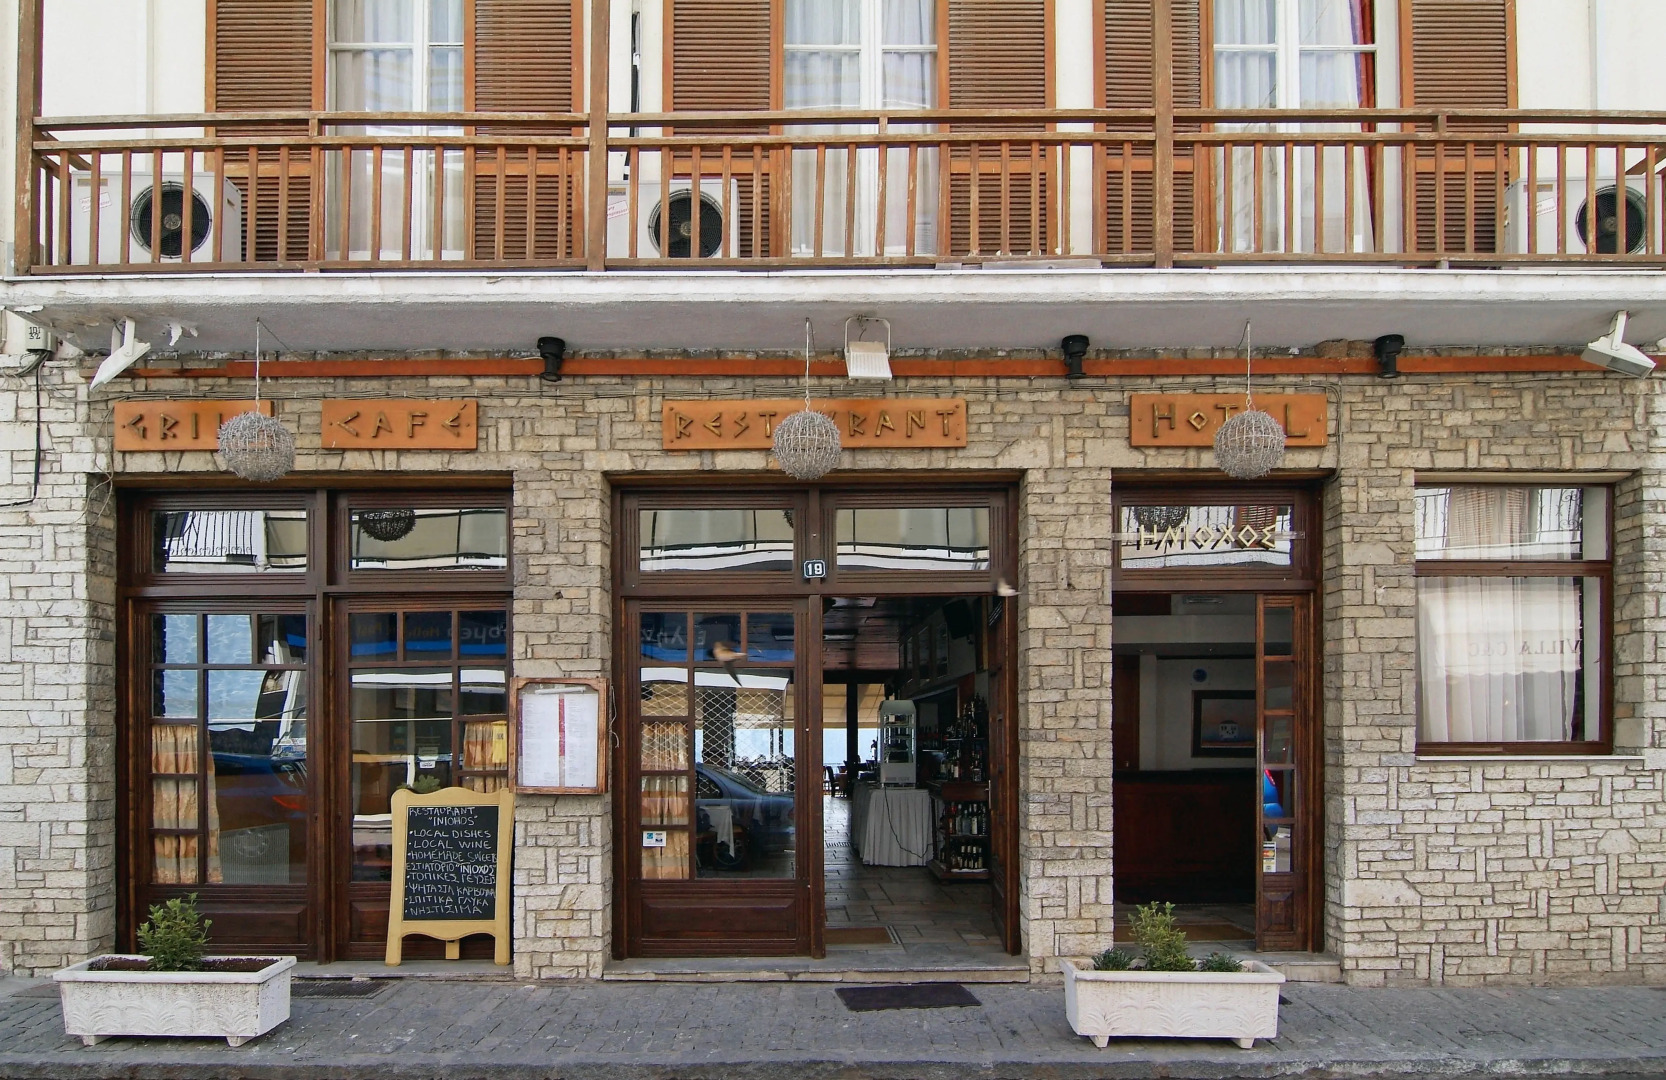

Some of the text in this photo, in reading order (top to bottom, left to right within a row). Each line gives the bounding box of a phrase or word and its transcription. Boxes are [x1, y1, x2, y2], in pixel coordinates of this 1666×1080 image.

[675, 409, 954, 438] RESTRANT
[1152, 403, 1307, 438] HOTL
[808, 563, 823, 575] 19
[409, 806, 475, 816] RESTAURANT
[413, 829, 491, 838] LOCAL DISHES
[413, 840, 492, 849] LOCAL WINE
